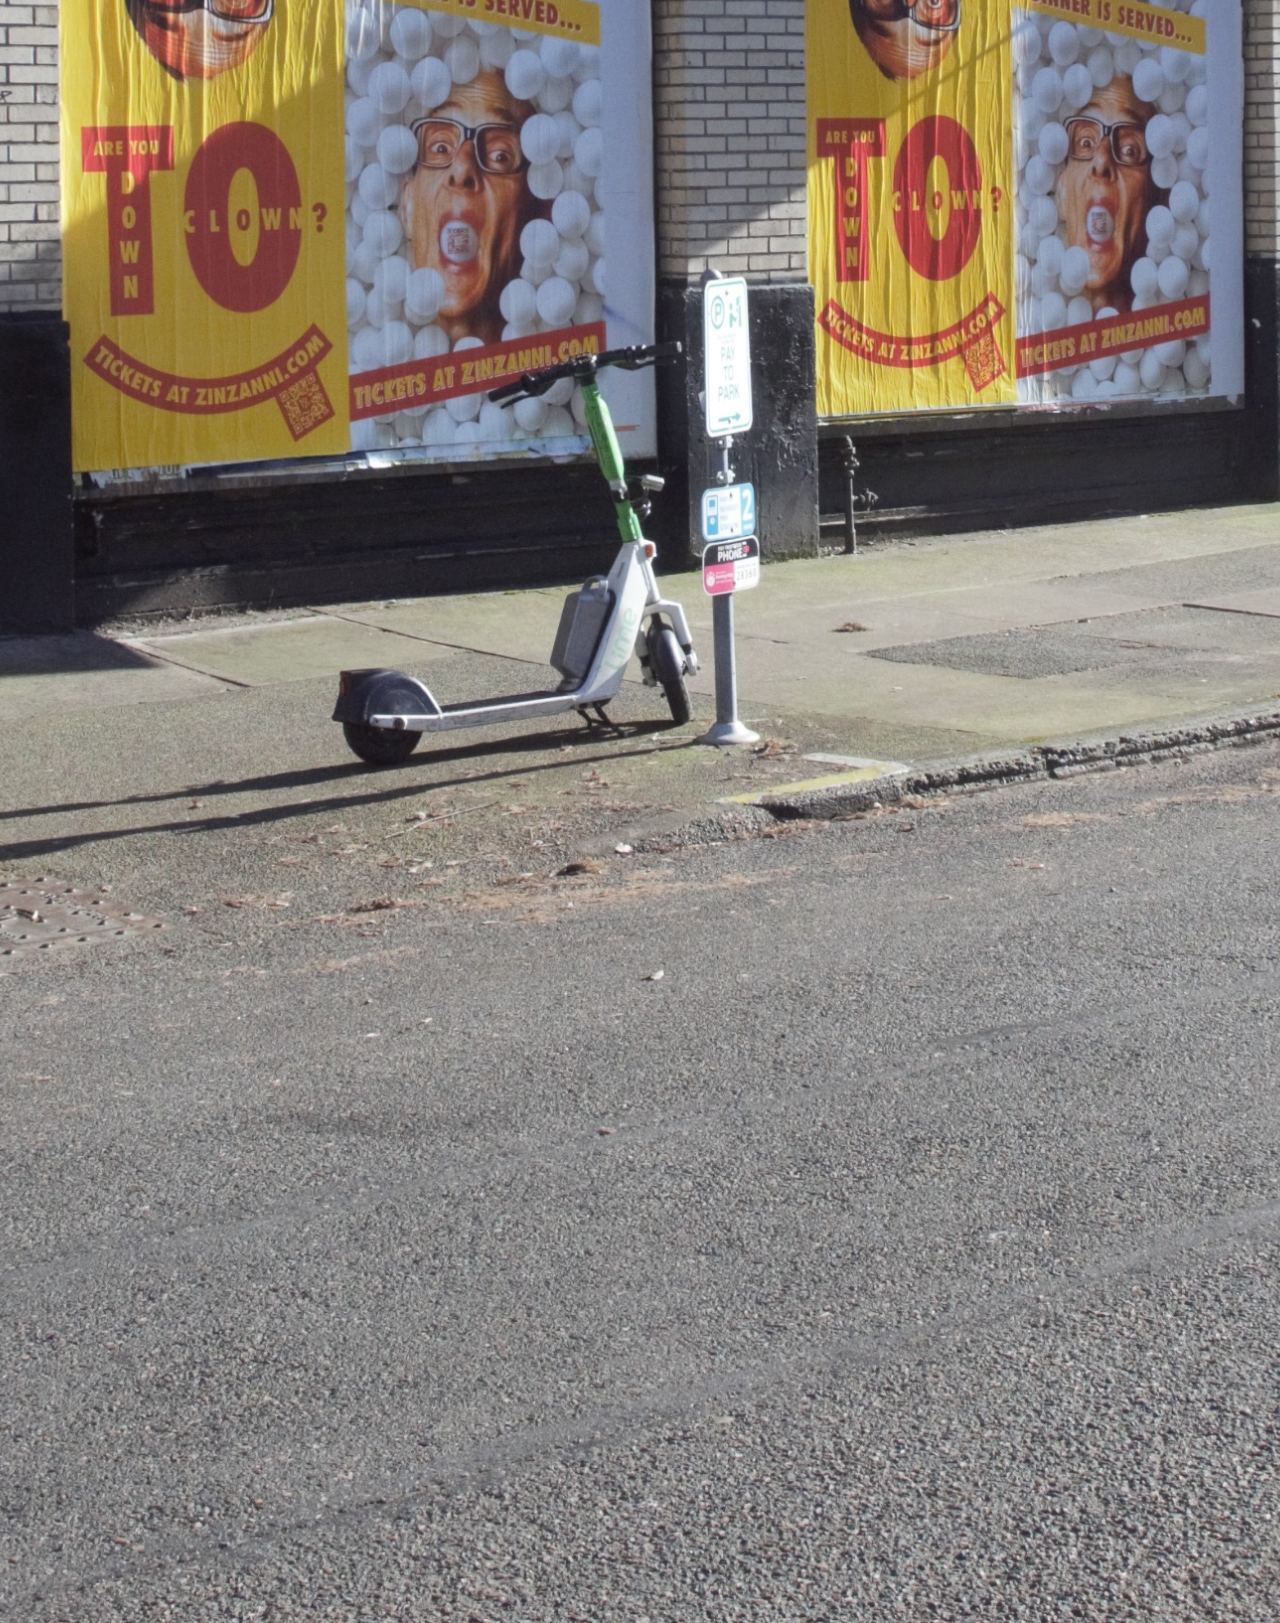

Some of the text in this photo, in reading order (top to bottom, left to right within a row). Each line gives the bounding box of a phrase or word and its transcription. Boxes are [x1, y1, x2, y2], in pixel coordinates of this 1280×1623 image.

[1097, 0, 1111, 22] IS
[93, 139, 160, 157] ARE YOU
[825, 130, 875, 144] ARE YOU
[81, 120, 303, 317] TO
[816, 114, 983, 283] TO
[842, 156, 860, 268] DOWN
[120, 171, 140, 299] DOWN
[720, 346, 736, 362] PAY
[825, 300, 999, 361] TICKETS AT ZINZANNI.COM
[1020, 306, 1206, 368] TICKETS AT ZINZANNI.COM
[94, 335, 325, 406] TICKETS AT ZINZANNI.COM
[353, 334, 599, 410] TICKETS AT ZINZANNI.COM
[718, 383, 740, 401] PARK
[723, 365, 734, 381] TO
[742, 489, 753, 521] 2
[718, 547, 743, 562] PHONE
[604, 606, 637, 670] Lime
